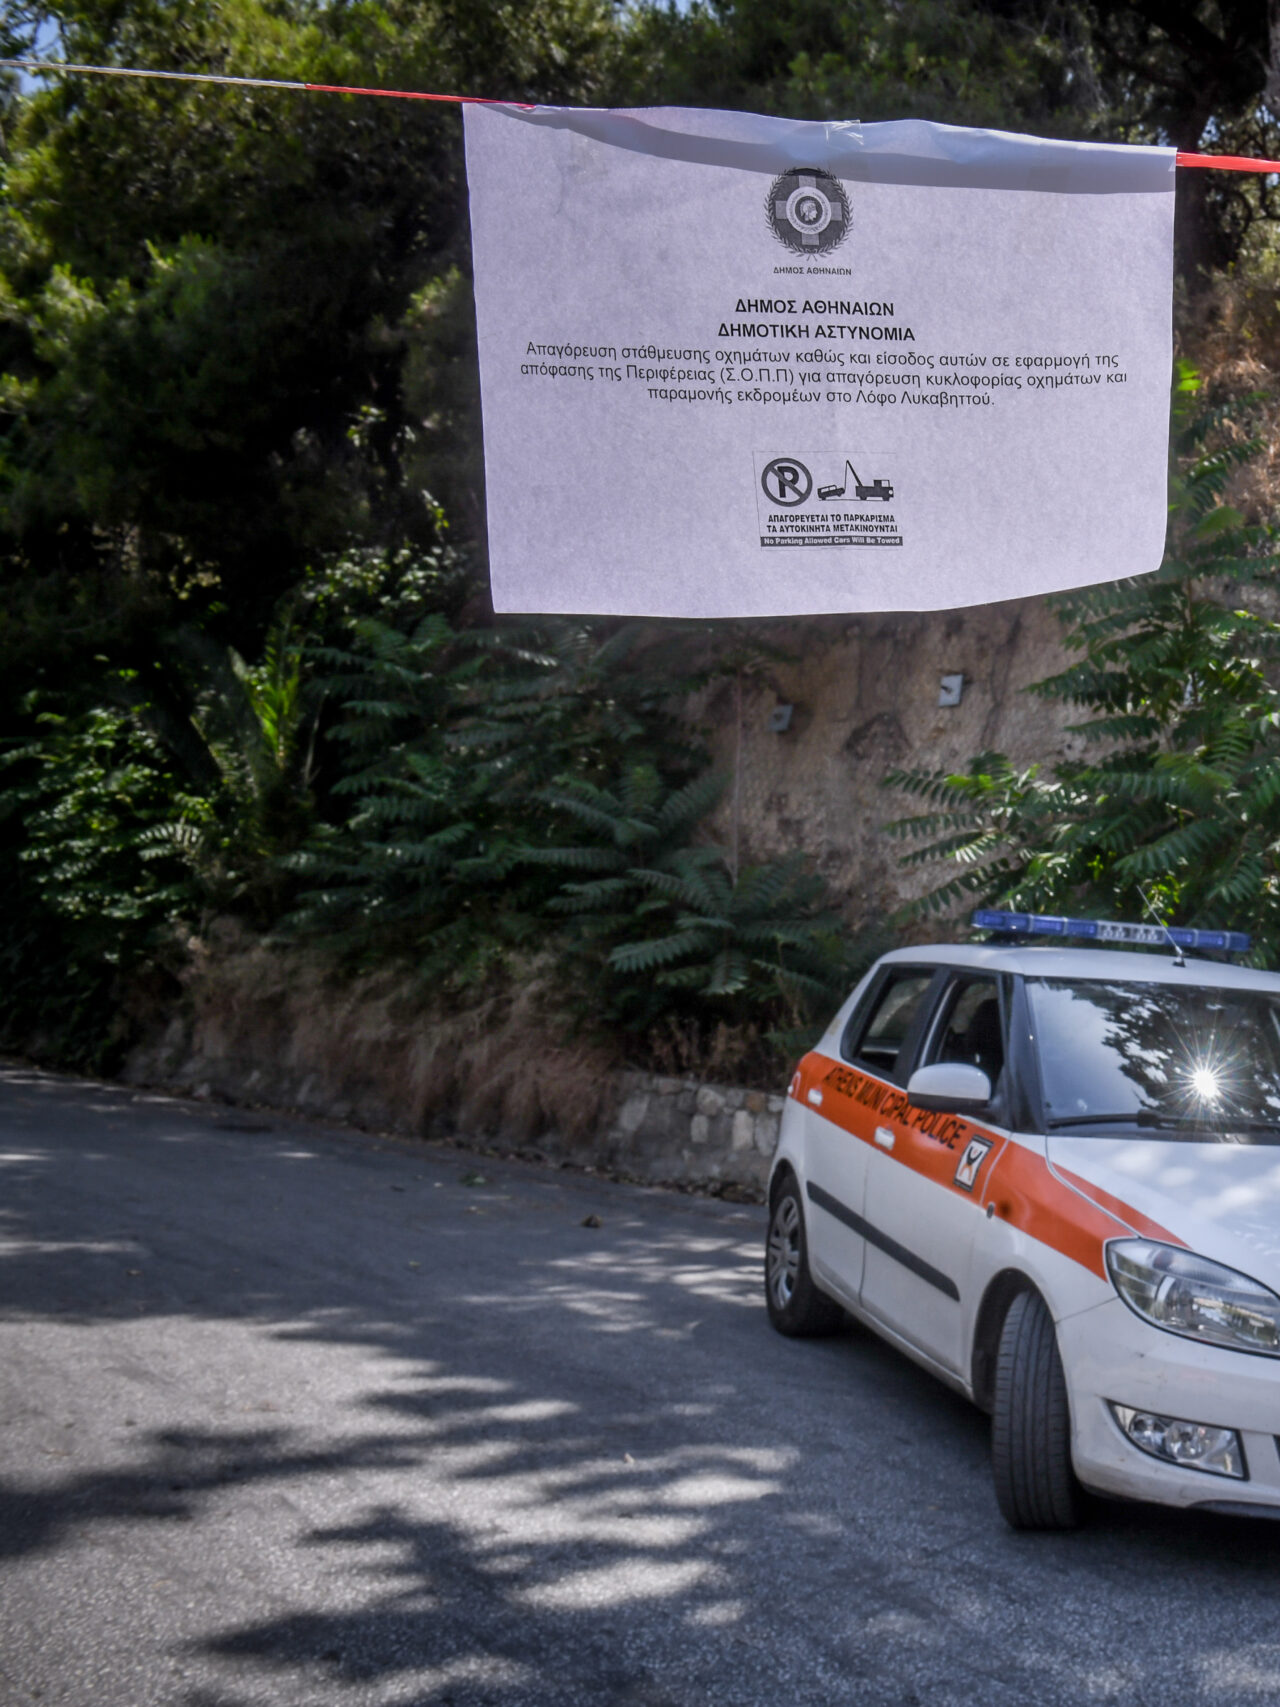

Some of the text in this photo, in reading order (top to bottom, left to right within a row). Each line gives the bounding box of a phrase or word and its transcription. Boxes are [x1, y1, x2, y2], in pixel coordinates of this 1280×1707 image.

[772, 266, 852, 276] ΔΗΜΟΣ ΑΘΗΝΑΙΩΝ
[734, 298, 895, 317] ΔΗΜΟΣ ΑΘΗΝΑΙΩΝ
[717, 322, 916, 342] ΔΗΜΟΤΙΚΗ ΑΣΤΥΝΟΜΙΑ
[526, 341, 1119, 371] Απαγόρευση στάθμευσης οχημάτων καθώς και είσοδος αυτών σε εφαρμογή της
[520, 361, 595, 381] απόφασης
[597, 366, 622, 382] της
[626, 364, 716, 385] Περιφέρειας
[798, 371, 822, 387] για
[825, 370, 921, 389] απαγόρευση
[926, 372, 1023, 390] κυκλοφορίας
[1026, 371, 1102, 390] οχημάτων
[1106, 372, 1127, 384] και
[647, 386, 995, 409] παραμονής εκδρομέων στο Λόφο Λυκαβηττού.
[768, 513, 895, 523] ΑΠΑΓΟΡΕΥΕΤΑΙ ΤΟ ΠΑΡΚΑΡΙΣΜΑ
[766, 524, 898, 533] ΤΑ ΑΥΤΟΚΙΝΗΤΑ ΜΕΤΑΚΙΝΟΥΝΤΑΙ
[764, 537, 774, 545] No
[775, 537, 803, 546] Parking
[804, 536, 832, 544] Allowed
[834, 536, 850, 544] Cars
[851, 536, 865, 544] Will
[876, 536, 901, 544] Towed
[911, 1107, 967, 1151] POLICE
